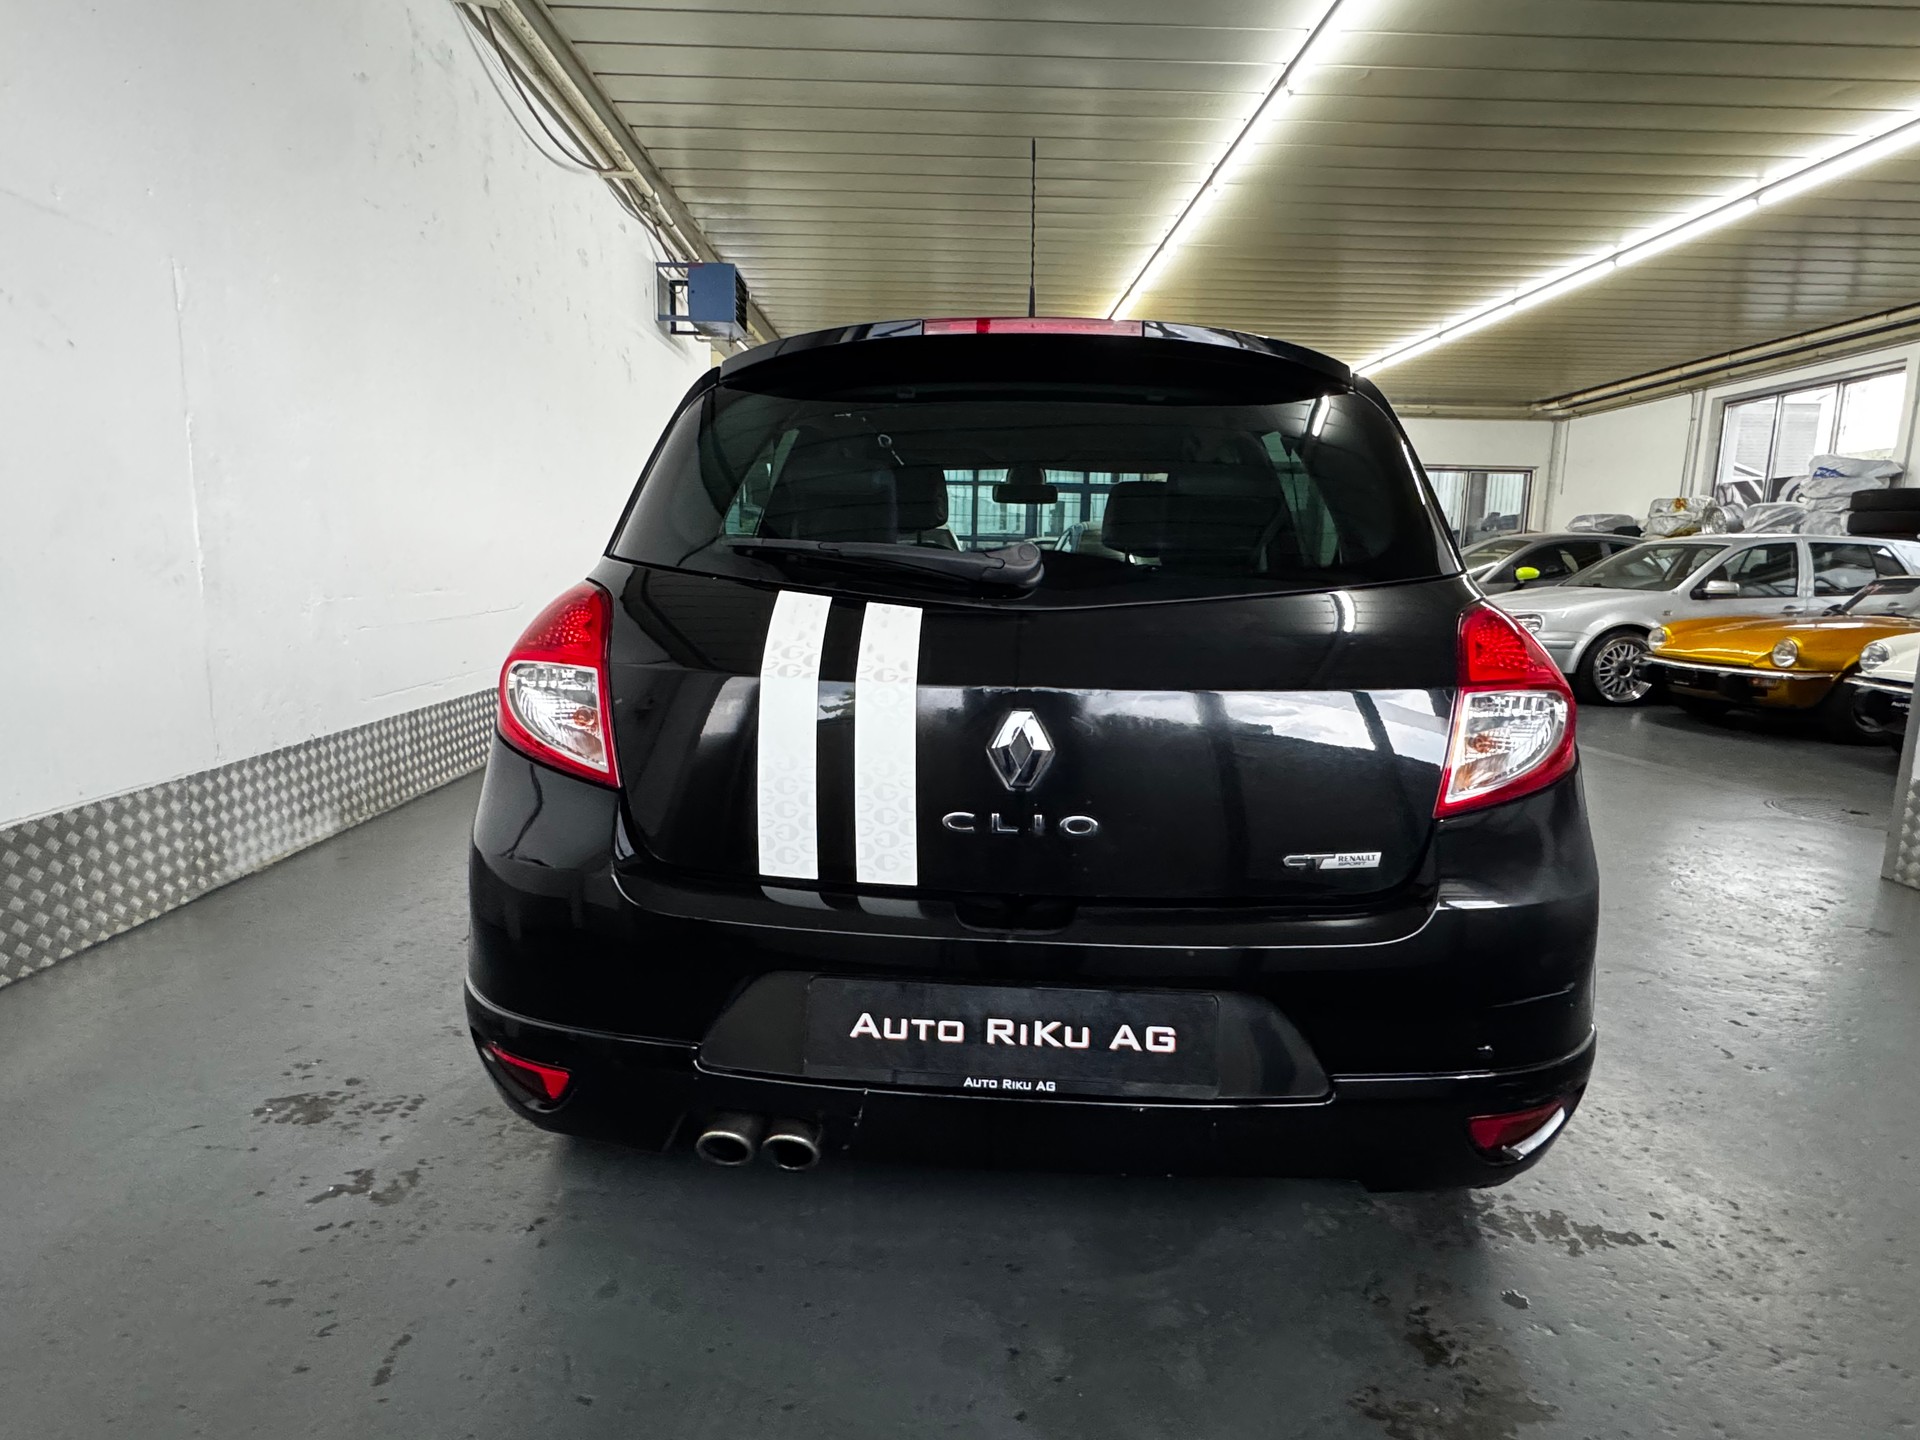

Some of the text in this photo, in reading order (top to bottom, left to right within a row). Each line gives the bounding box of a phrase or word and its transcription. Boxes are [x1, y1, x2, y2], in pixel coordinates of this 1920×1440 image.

[941, 811, 1099, 835] CLIO
[1338, 854, 1376, 862] RENAULT
[849, 1012, 965, 1044] AUTO
[1108, 1024, 1176, 1053] AG
[1035, 1080, 1056, 1092] AG
